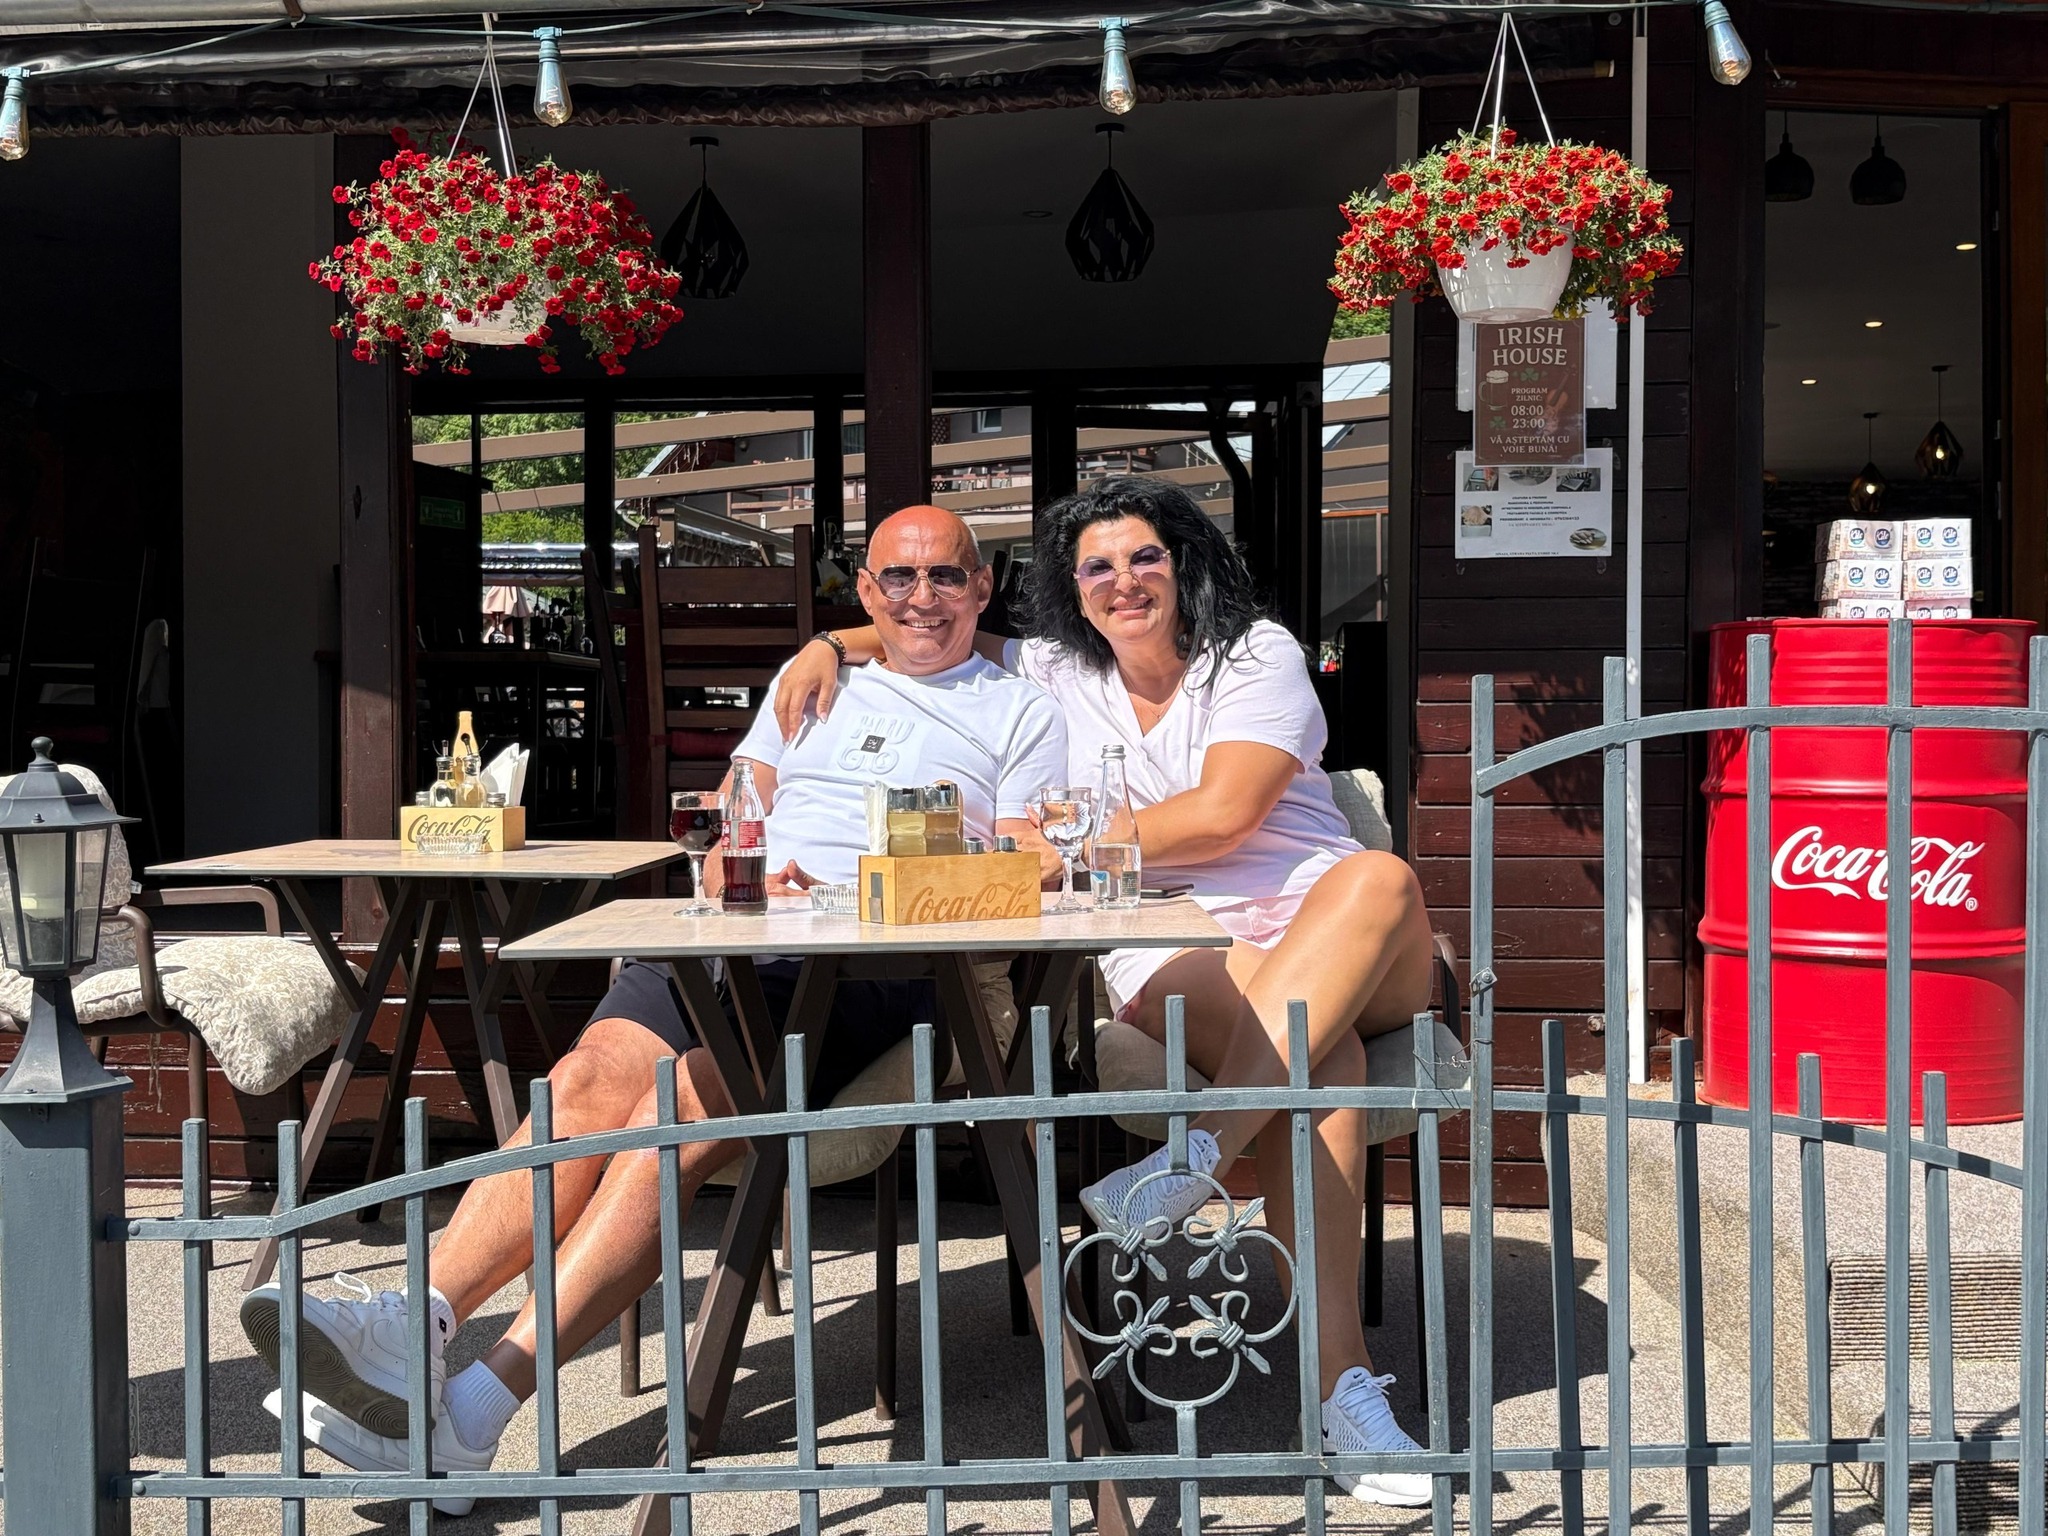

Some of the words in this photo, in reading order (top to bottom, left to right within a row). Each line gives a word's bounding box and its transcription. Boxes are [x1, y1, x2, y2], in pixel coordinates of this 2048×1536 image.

[1497, 326, 1564, 346] IRISH
[1492, 347, 1568, 366] HOUSE
[1511, 387, 1548, 395] PROGRAM
[1515, 394, 1543, 402] ZILNIC:
[1510, 405, 1544, 416] 08:00
[1512, 418, 1545, 429] 23:00
[1557, 436, 1570, 444] CU
[1502, 445, 1525, 454] VOIE
